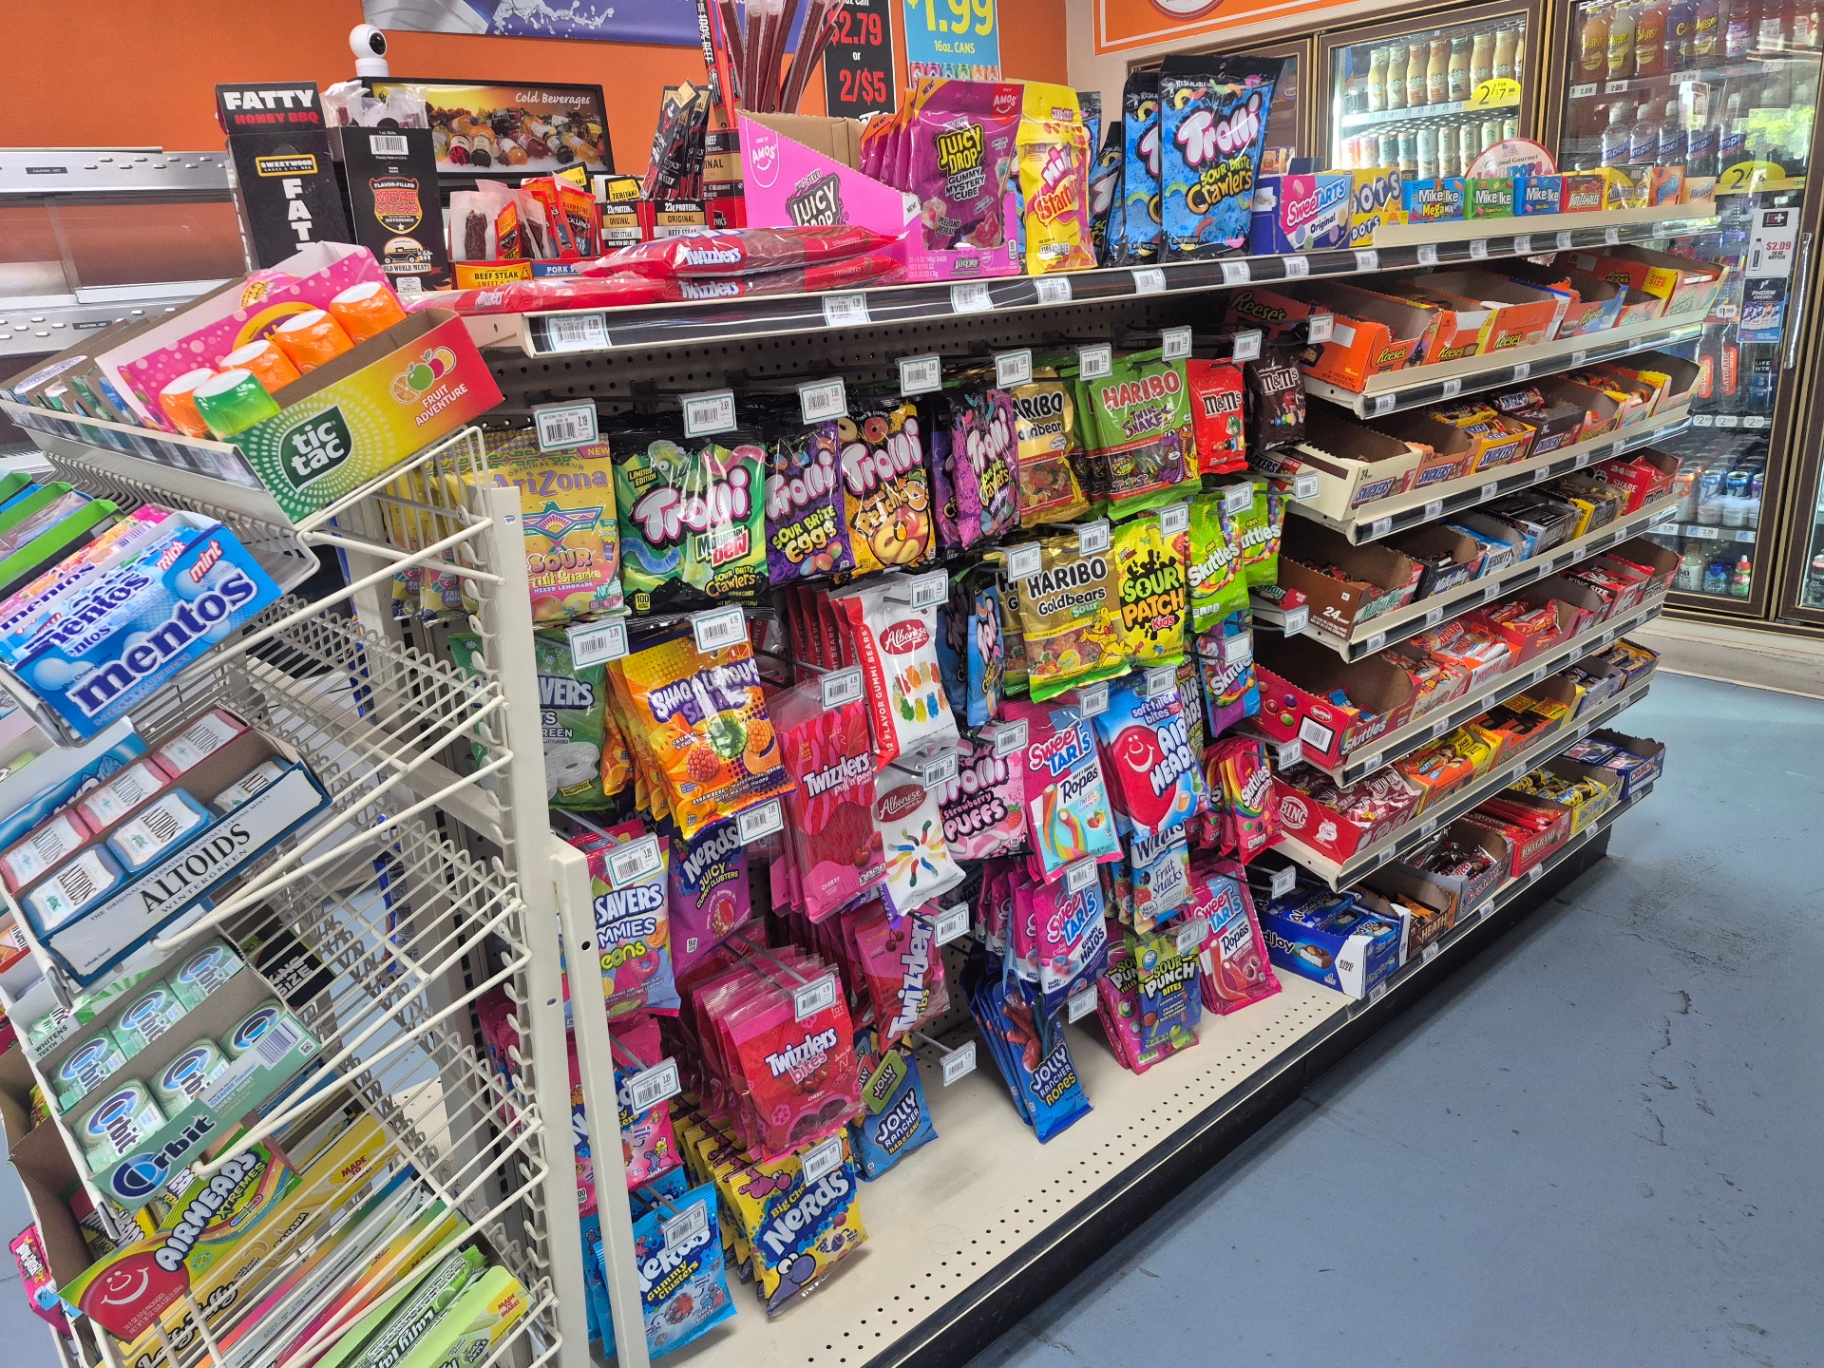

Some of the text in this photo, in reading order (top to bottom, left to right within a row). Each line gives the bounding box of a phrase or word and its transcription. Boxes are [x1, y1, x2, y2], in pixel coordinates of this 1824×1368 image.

[853, 51, 861, 61] or
[954, 42, 976, 54] CANS
[223, 89, 314, 110] FATTY
[515, 91, 590, 106] Cold Beverages
[839, 68, 887, 105] 2/$5
[234, 112, 319, 125] HONEY BBQ
[1177, 92, 1261, 164] Trolli
[939, 129, 983, 164] JUICY
[1511, 154, 1538, 163] Gourmet
[260, 159, 313, 168] SWEETWOOD
[948, 167, 982, 184] GUMMY
[949, 149, 978, 175] DROP
[1201, 163, 1227, 184] SOUR
[376, 191, 416, 204] MEAT
[612, 192, 638, 200] TERIYAKI
[946, 175, 985, 196] MYSTERY
[954, 188, 979, 201] CUBE
[1187, 170, 1252, 213] Crawlers
[1418, 189, 1443, 203] Mike
[1475, 190, 1497, 204] Mike
[377, 204, 419, 214] STICKS
[793, 181, 836, 226] JUICY
[1423, 204, 1445, 218] Mega
[667, 214, 695, 223] ORIGINAL
[1310, 213, 1336, 235] Original
[1351, 215, 1381, 241] DOTS
[679, 246, 741, 266] Twizzlers
[1766, 241, 1792, 251] $2.09
[474, 271, 518, 280] BEEF STEAK
[477, 280, 500, 288] SWEET
[678, 280, 739, 299] Twizzlers
[1376, 346, 1407, 365] Reese's
[421, 384, 450, 410] FRUIT
[1102, 370, 1182, 411] HARIBO
[414, 382, 469, 427] ADVENTURE
[1717, 415, 1735, 426] $2.99
[292, 421, 336, 455] tic
[588, 446, 609, 457] NEW
[966, 407, 1010, 475] Trolli
[293, 437, 345, 477] tac
[841, 418, 923, 494] Trolli
[1480, 442, 1518, 465] SNICKERS
[508, 462, 549, 477] ORIGINAL
[634, 471, 658, 488] EDITION
[1418, 462, 1453, 484] SNICKERS
[764, 449, 836, 521] Trolli
[1356, 478, 1393, 502] SNICKERS
[1613, 478, 1639, 494] SHARE
[634, 467, 751, 543] Trolli
[771, 504, 838, 549] SOUR BRITE
[189, 539, 224, 583] mint
[528, 546, 594, 574] SOUR
[734, 566, 756, 579] BRITE
[1188, 541, 1241, 588] Skittles
[534, 581, 594, 594] MIXED LEMONADE
[705, 573, 757, 598] Crawlers
[1027, 556, 1107, 600] HARIBO
[1123, 566, 1180, 602] SOUR
[1590, 585, 1610, 597] SIZE
[635, 593, 649, 604] 100
[1038, 586, 1106, 617] Goldbears
[1071, 601, 1099, 618] Sour
[1122, 587, 1185, 627] PATCH
[1151, 614, 1176, 631] Kids
[1322, 606, 1339, 620] 24
[72, 572, 254, 714] mentos
[63, 678, 76, 690] The
[75, 664, 98, 683] Chewy
[862, 630, 892, 738] FLAVOR GUMMI BEARS
[1131, 693, 1176, 718] soft filled
[1145, 710, 1170, 725] bites
[182, 725, 224, 754] ALTOIDS
[1342, 719, 1387, 755] Skittles
[803, 751, 871, 799] Twizzlers
[1059, 768, 1098, 804] Ropes
[1241, 764, 1272, 808] Skittles
[109, 773, 148, 807] ALTOIDS
[878, 788, 923, 820] Albanese
[944, 790, 992, 819] Strawberry
[1279, 803, 1309, 826] BING
[140, 806, 184, 843] ALTOIDS
[944, 800, 1007, 844] PUFFS
[30, 828, 65, 865] ALTOIDS
[89, 794, 272, 922] THE ORIGINAL CELEBRATED CURIOUSLY STRONG MINTS
[139, 822, 252, 915] ALTOIDS
[160, 848, 249, 914] WINTERGREEN
[700, 862, 727, 892] JUICY
[1155, 858, 1176, 882] Fruit
[57, 863, 97, 907] ALTOIDS
[594, 884, 664, 923] SAVERS
[1220, 924, 1250, 956] Ropes
[1421, 913, 1448, 941] HEATH
[1079, 927, 1106, 966] HALOS
[1153, 955, 1183, 978] SOUR
[1144, 961, 1196, 1000] PUNCH
[1161, 982, 1183, 997] BITES
[35, 1024, 69, 1054] WHITENS
[38, 1041, 58, 1058] TEETH
[764, 1026, 838, 1077] Twizzlers
[788, 1050, 828, 1084] bites
[1032, 1044, 1069, 1092] JOLLY
[1039, 1062, 1073, 1099] RANCHER
[873, 1064, 895, 1099] JOLLY
[1046, 1073, 1077, 1107] ROPES
[874, 1088, 919, 1144] JOLLY
[884, 1107, 921, 1148] RANCHER
[888, 1134, 905, 1155] HARD
[215, 1160, 267, 1220] XTREMES
[155, 1149, 262, 1272] AIRHEADS
[770, 1200, 791, 1218] Big
[497, 1292, 518, 1311] MADE
